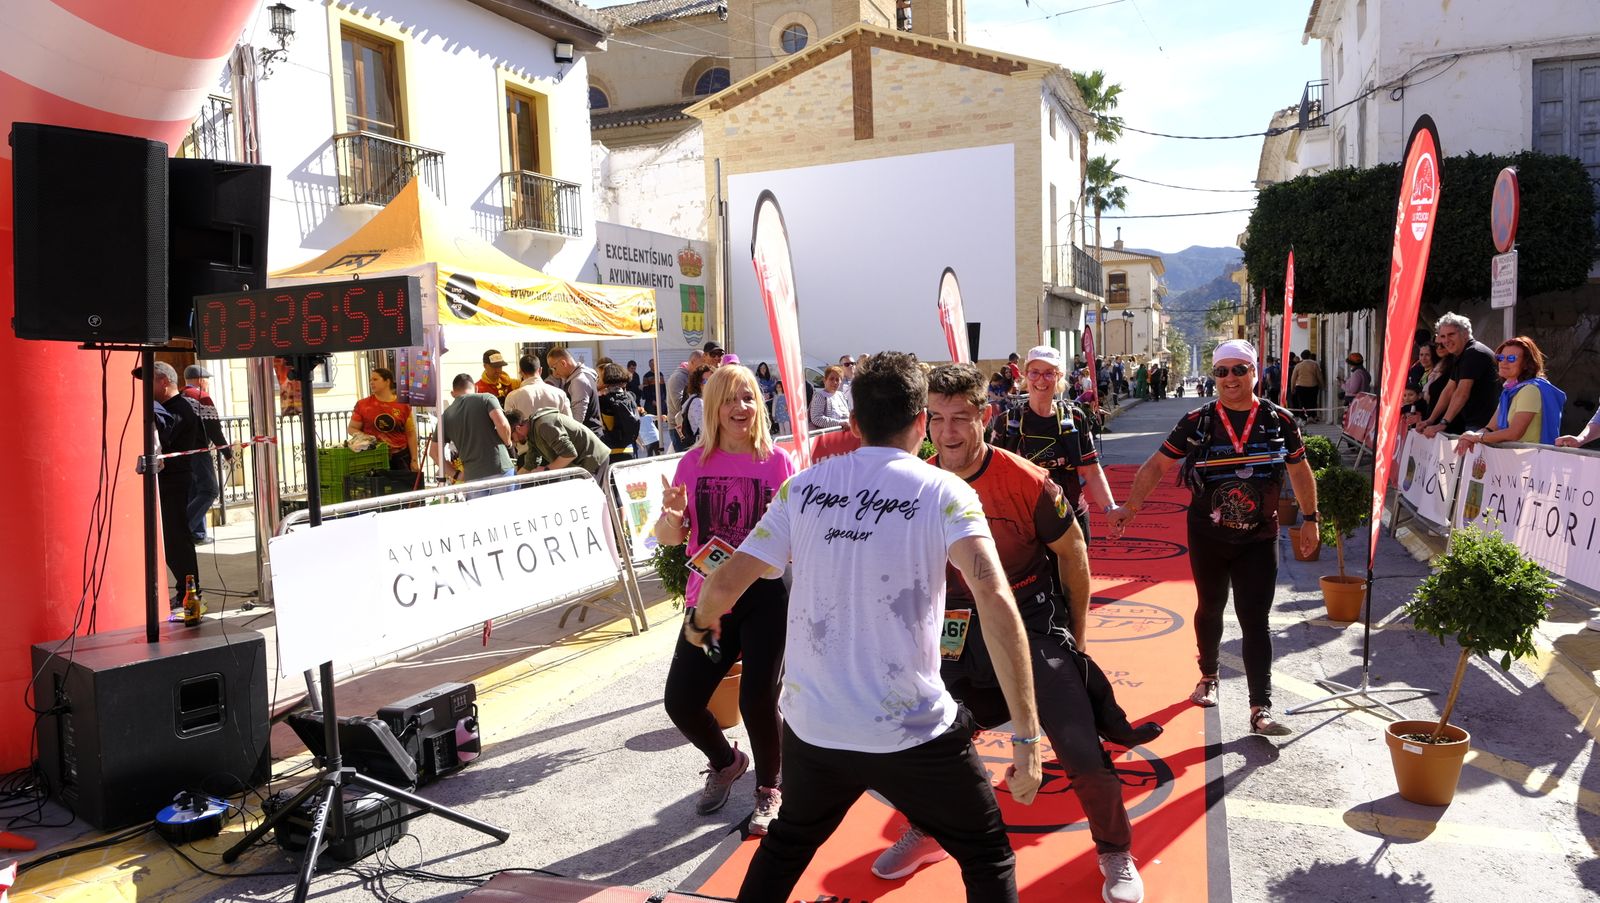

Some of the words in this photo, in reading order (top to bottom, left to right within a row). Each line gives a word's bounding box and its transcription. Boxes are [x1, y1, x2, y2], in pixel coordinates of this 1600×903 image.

[605, 243, 674, 268] EXCELENTÍSIMO
[609, 267, 674, 289] AYUNTAMIENTO
[203, 287, 405, 353] 03:26:54
[801, 483, 851, 518] Pepe
[855, 489, 920, 525] Yepes
[1481, 492, 1600, 554] CANTORI
[388, 511, 563, 564] AYUNTAMIENTO
[569, 505, 590, 523] DE
[824, 527, 874, 545] speaker
[392, 526, 603, 608] CANTORIA
